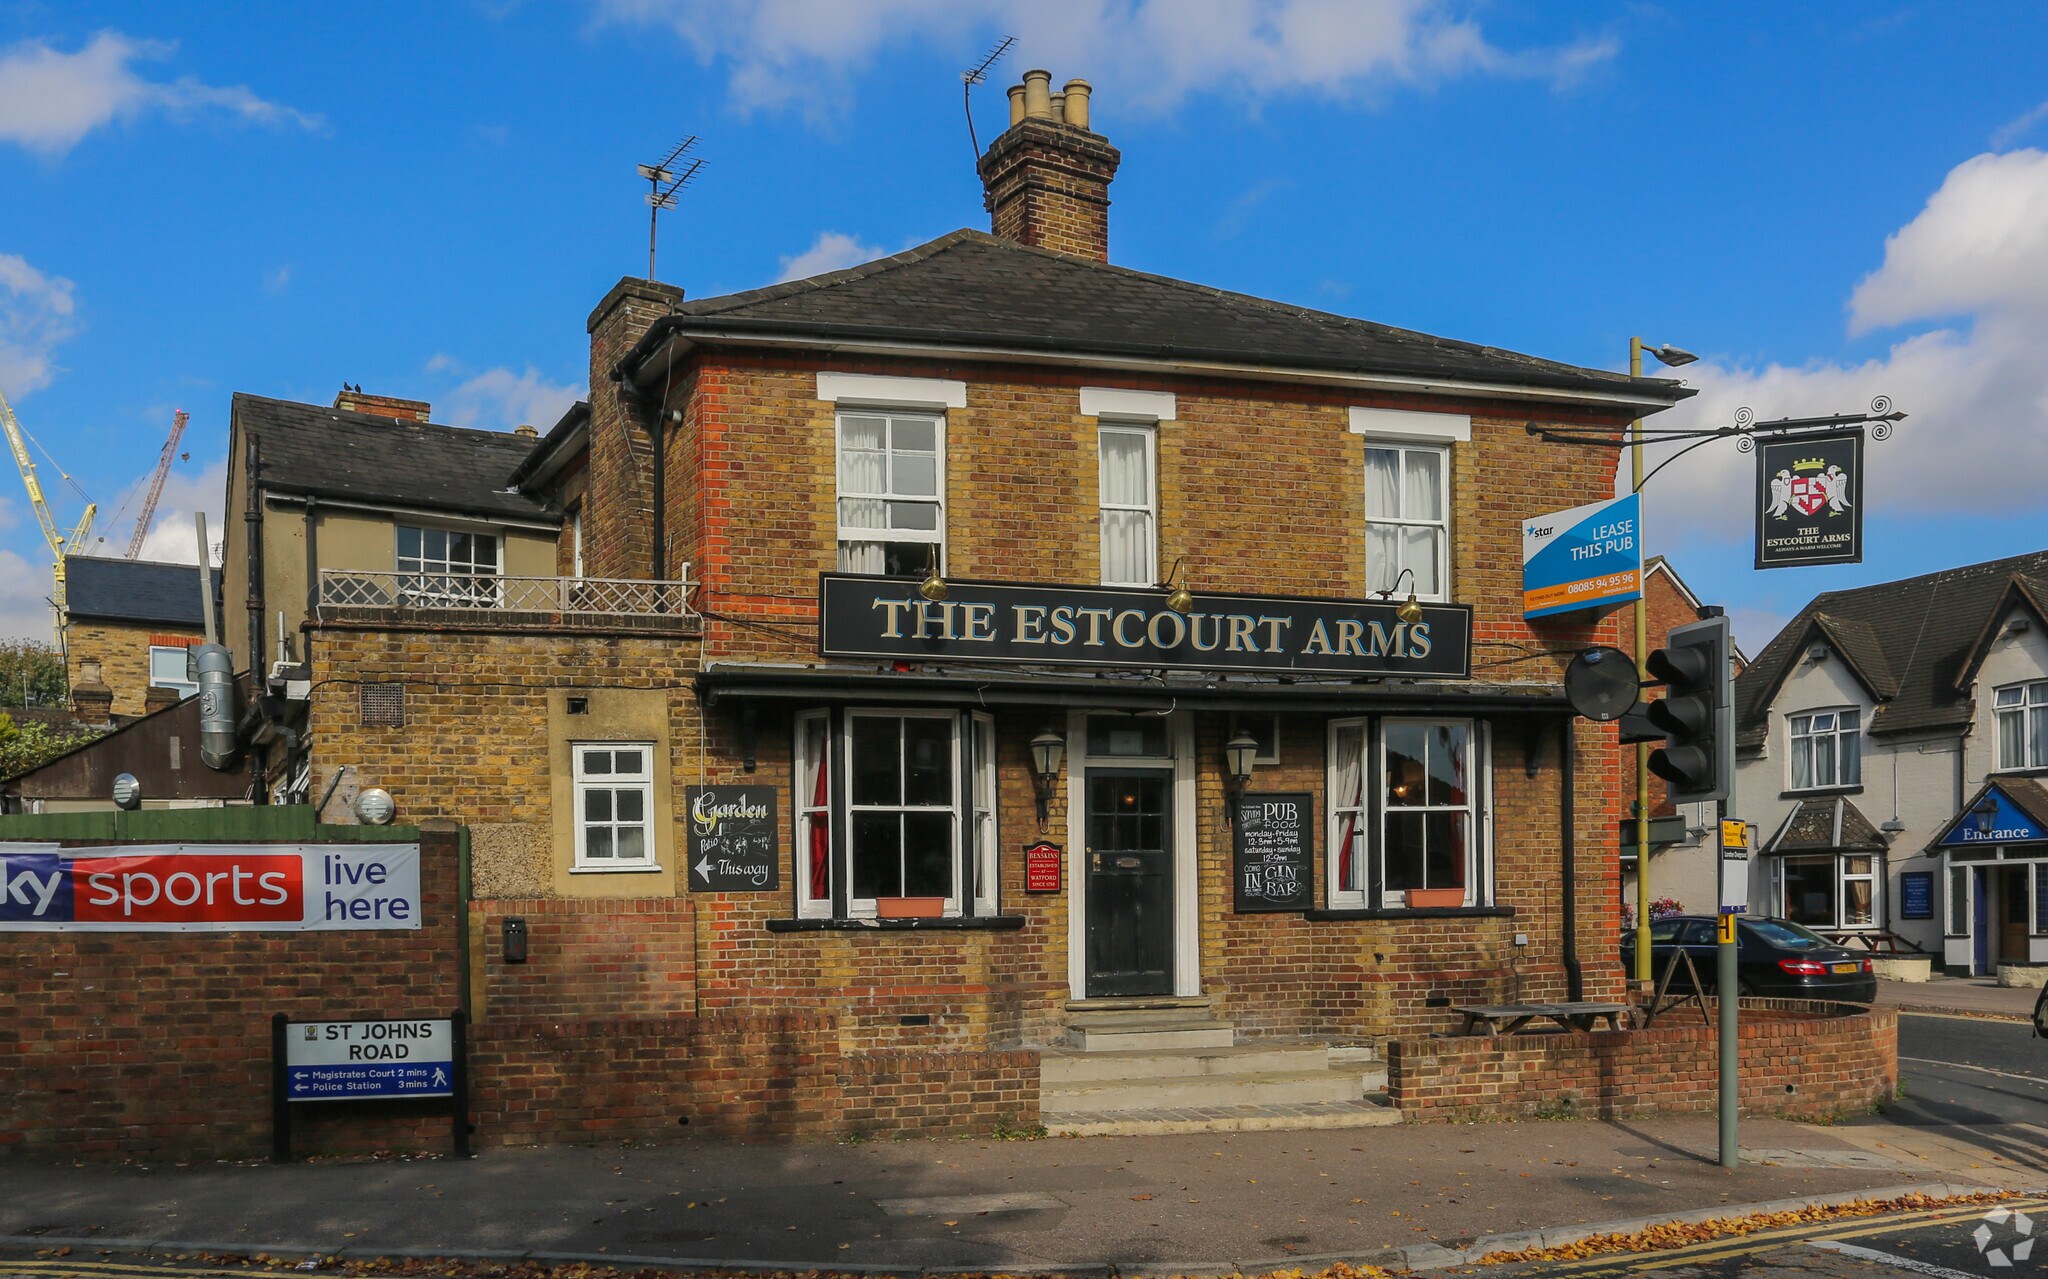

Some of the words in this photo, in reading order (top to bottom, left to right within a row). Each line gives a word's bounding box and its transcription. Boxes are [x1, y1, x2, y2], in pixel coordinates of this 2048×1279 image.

[1534, 526, 1554, 538] star
[1592, 519, 1634, 541] LEASE
[1797, 526, 1820, 536] THE
[1570, 541, 1603, 561] THIS
[1605, 536, 1634, 554] PUB
[1766, 535, 1820, 547] ESTCOURT
[1821, 533, 1851, 543] ARMS
[1567, 580, 1595, 595] 08085
[1596, 578, 1608, 590] 94
[1609, 575, 1621, 587] 95
[1622, 572, 1634, 583] 96
[872, 597, 998, 642] THE
[1011, 605, 1292, 653] ESTCOURT
[1301, 618, 1432, 659] ARMS
[692, 791, 769, 837] Garden
[1262, 802, 1298, 821] PUB
[1263, 820, 1300, 829] food
[700, 837, 719, 854] Patio
[1244, 846, 1273, 855] saturday
[1277, 845, 1301, 854] sunday
[324, 854, 387, 885] live
[1265, 865, 1298, 880] GIN
[1244, 872, 1262, 889] IN
[1266, 881, 1298, 896] BAR
[89, 864, 288, 916] sports
[324, 891, 411, 921] here
[325, 1024, 352, 1041] ST
[361, 1023, 433, 1040] JOHNS
[349, 1043, 409, 1060] ROAD
[312, 1068, 366, 1081] Magistrates
[368, 1069, 395, 1078] Court
[397, 1069, 404, 1077] 2
[406, 1068, 428, 1077] mins
[312, 1083, 343, 1091] Police
[346, 1081, 382, 1090] Station
[398, 1080, 404, 1088] 3
[405, 1080, 428, 1088] mins
